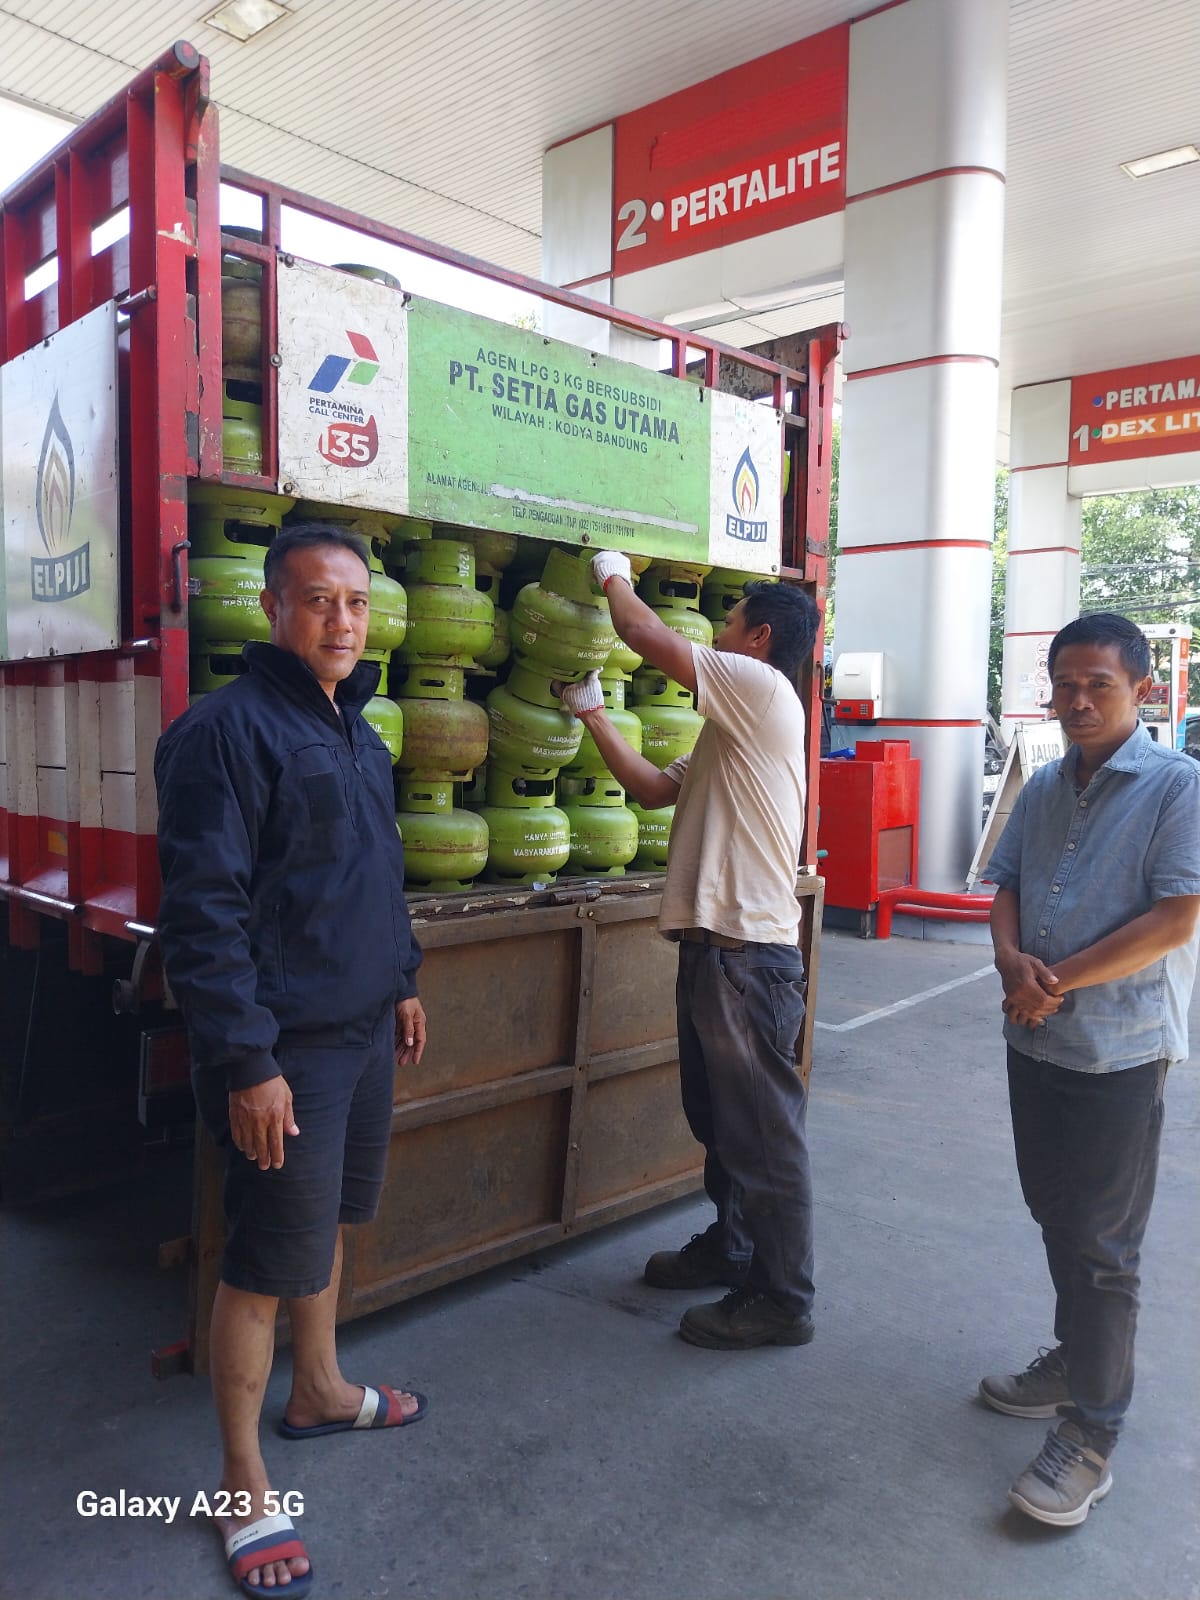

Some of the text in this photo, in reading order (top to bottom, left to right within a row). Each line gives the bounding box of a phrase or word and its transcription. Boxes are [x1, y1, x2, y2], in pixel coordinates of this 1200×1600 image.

[671, 142, 840, 232] PERTALITE
[616, 199, 647, 251] 2
[476, 348, 661, 412] AGEN LPG 3 KG BERSUBSIDI
[1106, 378, 1200, 410] PERTAM
[309, 397, 365, 416] PERTAMINA
[309, 405, 365, 424] CALL CENTER
[450, 360, 680, 444] PT. SETIA GAS UTAMA
[491, 403, 545, 429] WILAYAH
[555, 420, 593, 441] KODYA
[596, 430, 648, 453] BANDUNG
[1073, 425, 1089, 452] 1
[1102, 418, 1156, 439] DEX
[321, 427, 370, 462] 135
[427, 472, 456, 488] ALAMAT
[728, 518, 766, 540] ELPIJI
[34, 552, 89, 596] ELPIJI
[1031, 743, 1061, 764] JALUR
